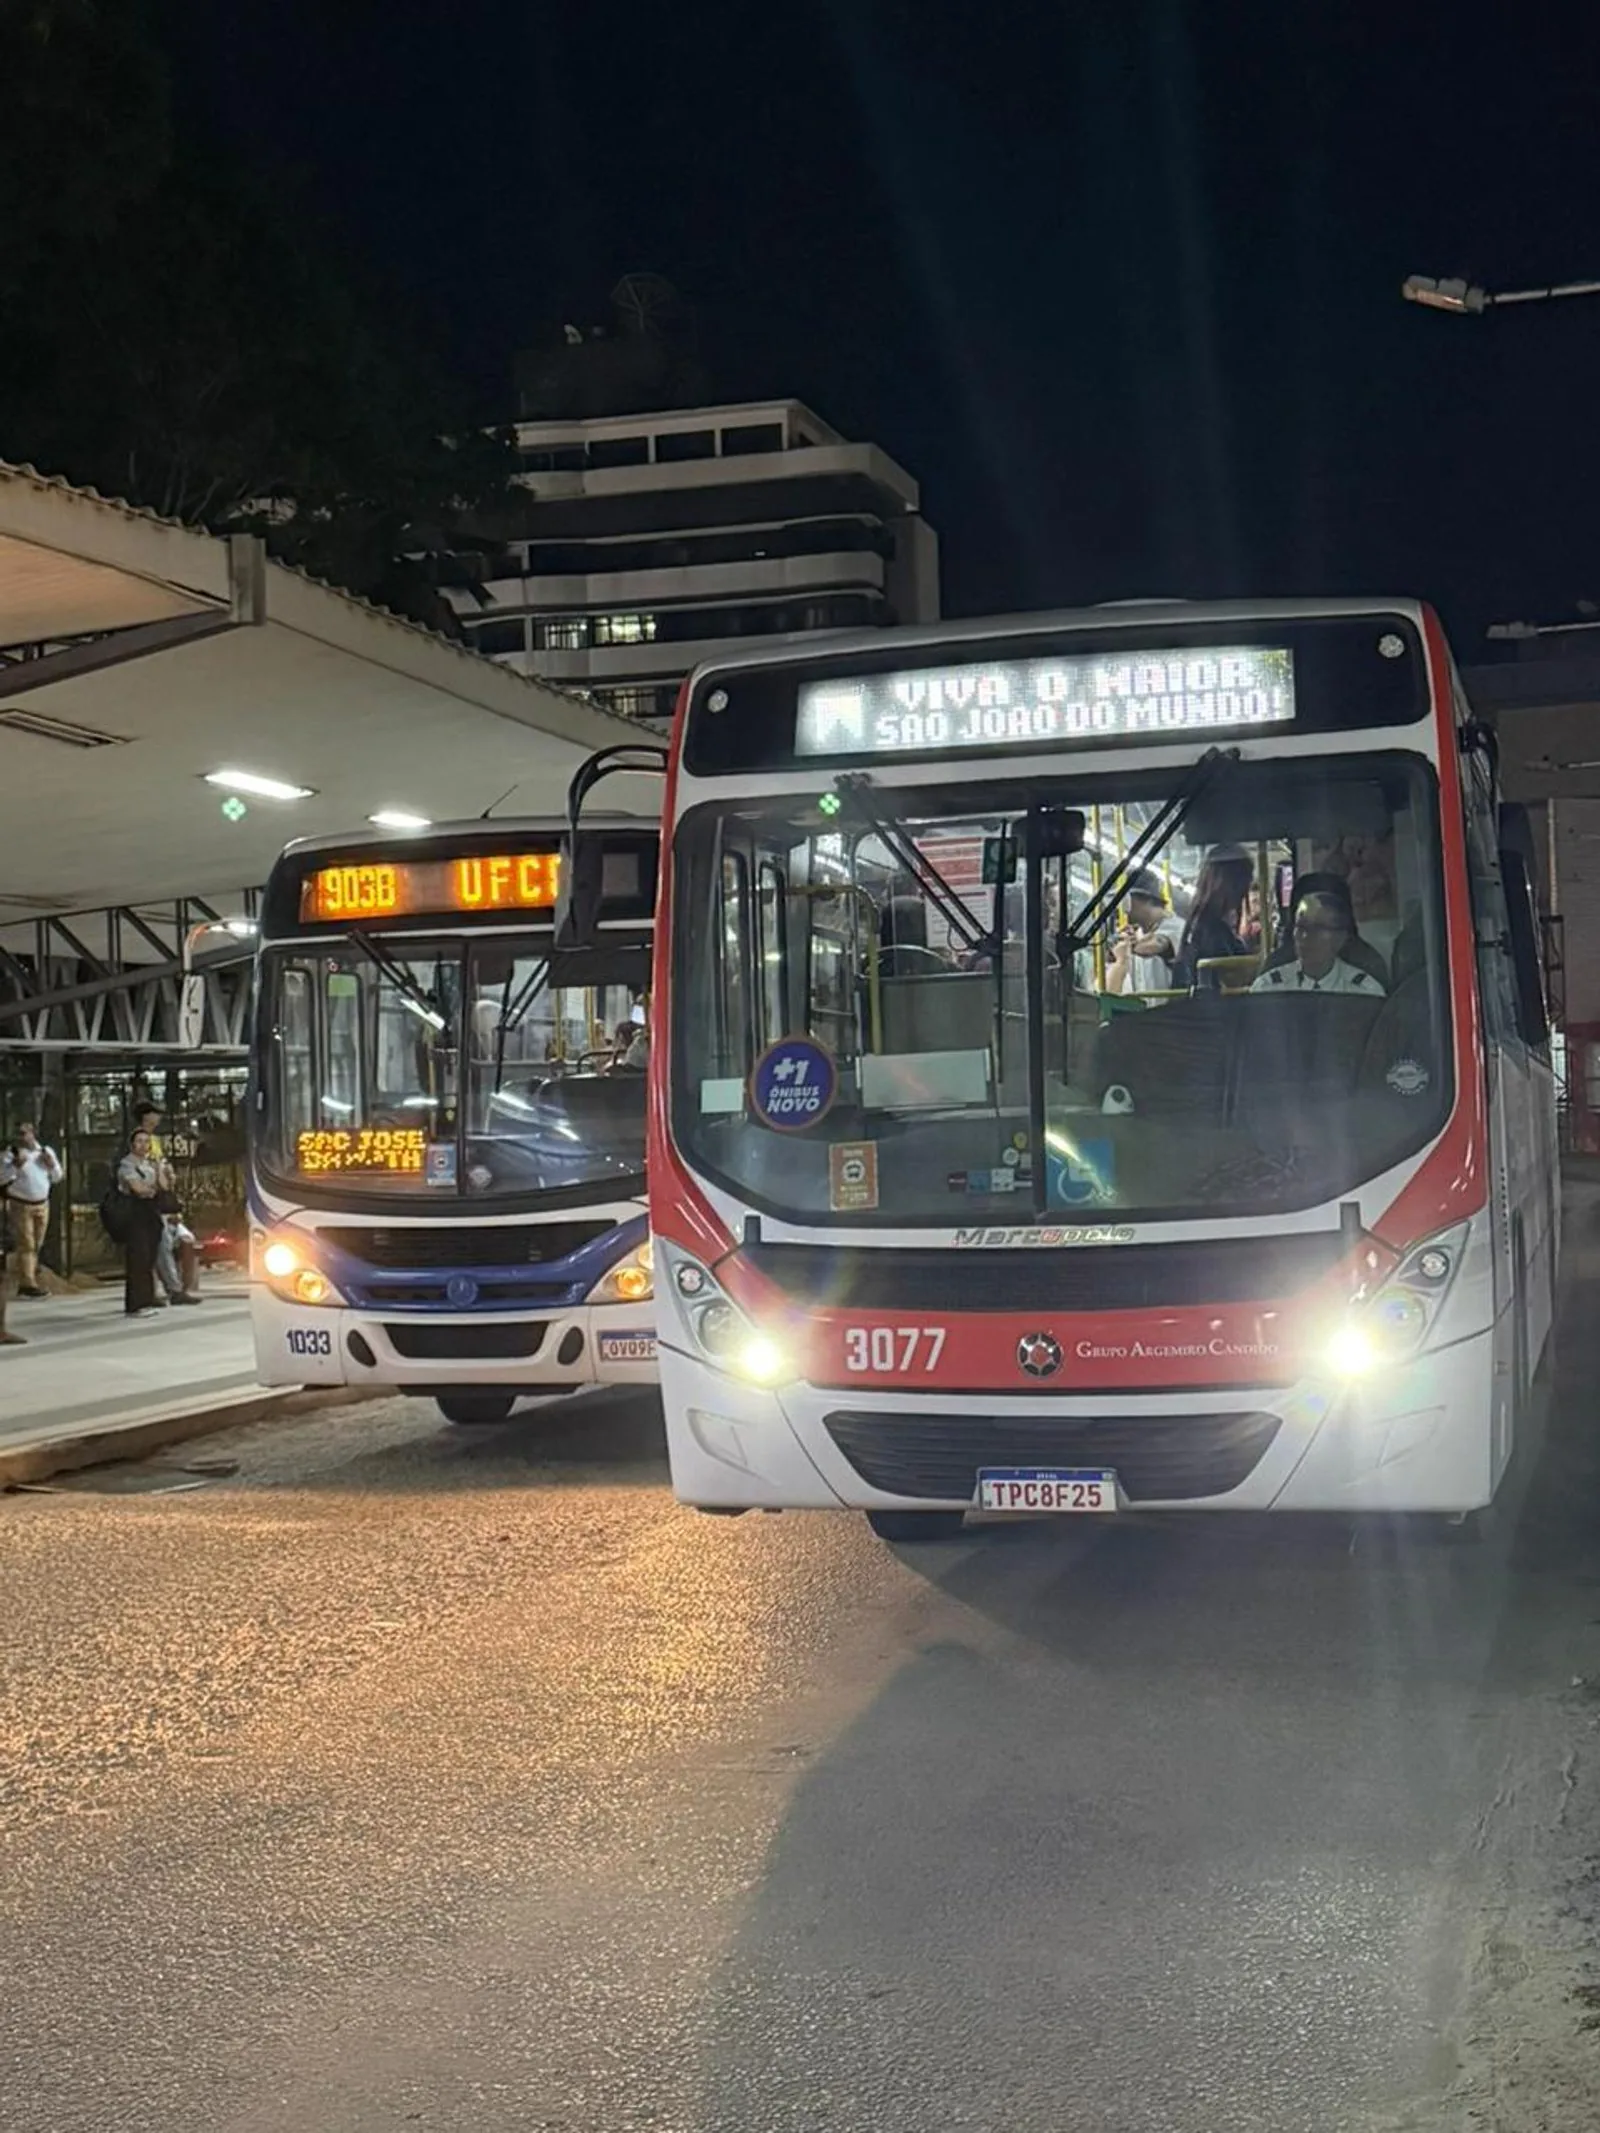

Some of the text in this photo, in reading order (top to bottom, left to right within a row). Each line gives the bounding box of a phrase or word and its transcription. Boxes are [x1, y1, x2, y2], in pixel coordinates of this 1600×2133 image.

[896, 657, 1252, 709] VIVA O MAIOR
[1066, 701, 1115, 732] DO
[1127, 685, 1282, 730] MUNDO!
[773, 1058, 810, 1085] +1
[766, 1098, 821, 1113] NOVO
[955, 1226, 1136, 1246] Marcopolo
[286, 1329, 331, 1355] 1033
[845, 1327, 946, 1371] 3077
[992, 1482, 1102, 1508] TPC8F25
